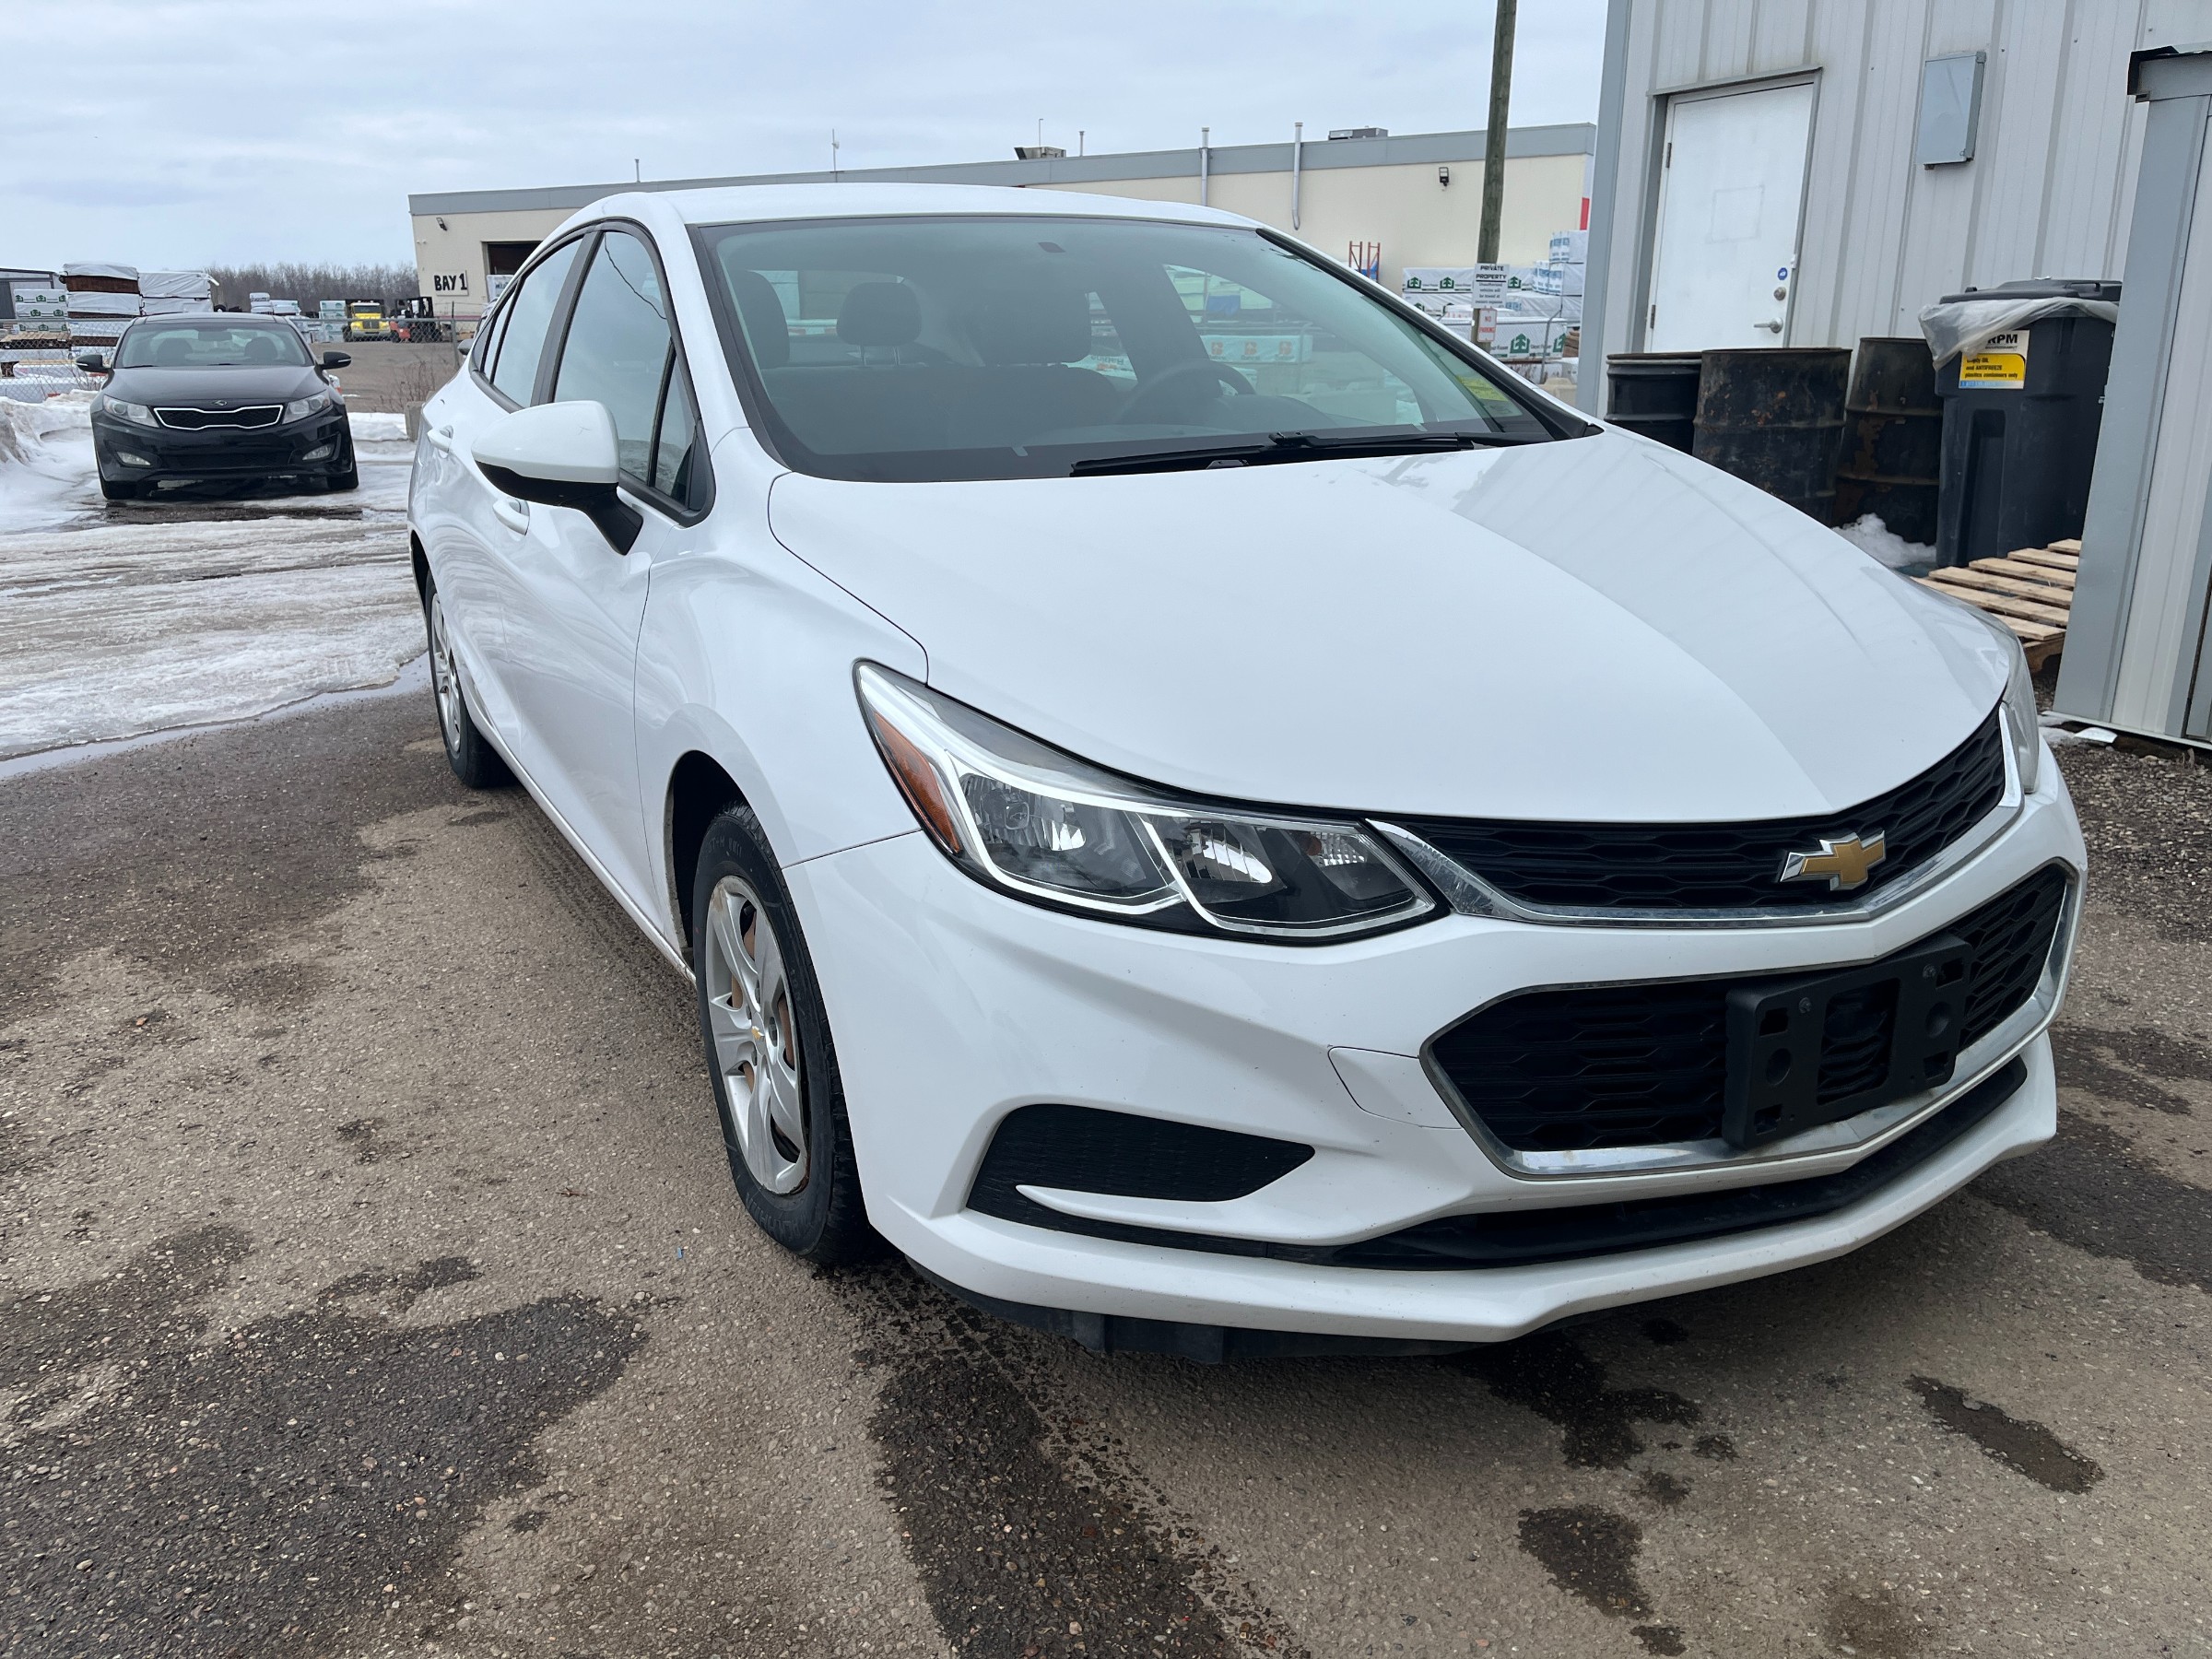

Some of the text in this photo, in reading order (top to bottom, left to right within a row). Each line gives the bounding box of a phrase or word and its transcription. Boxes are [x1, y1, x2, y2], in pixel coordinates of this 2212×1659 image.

[434, 273, 467, 291] BAY 1
[1988, 335, 2018, 344] RPM
